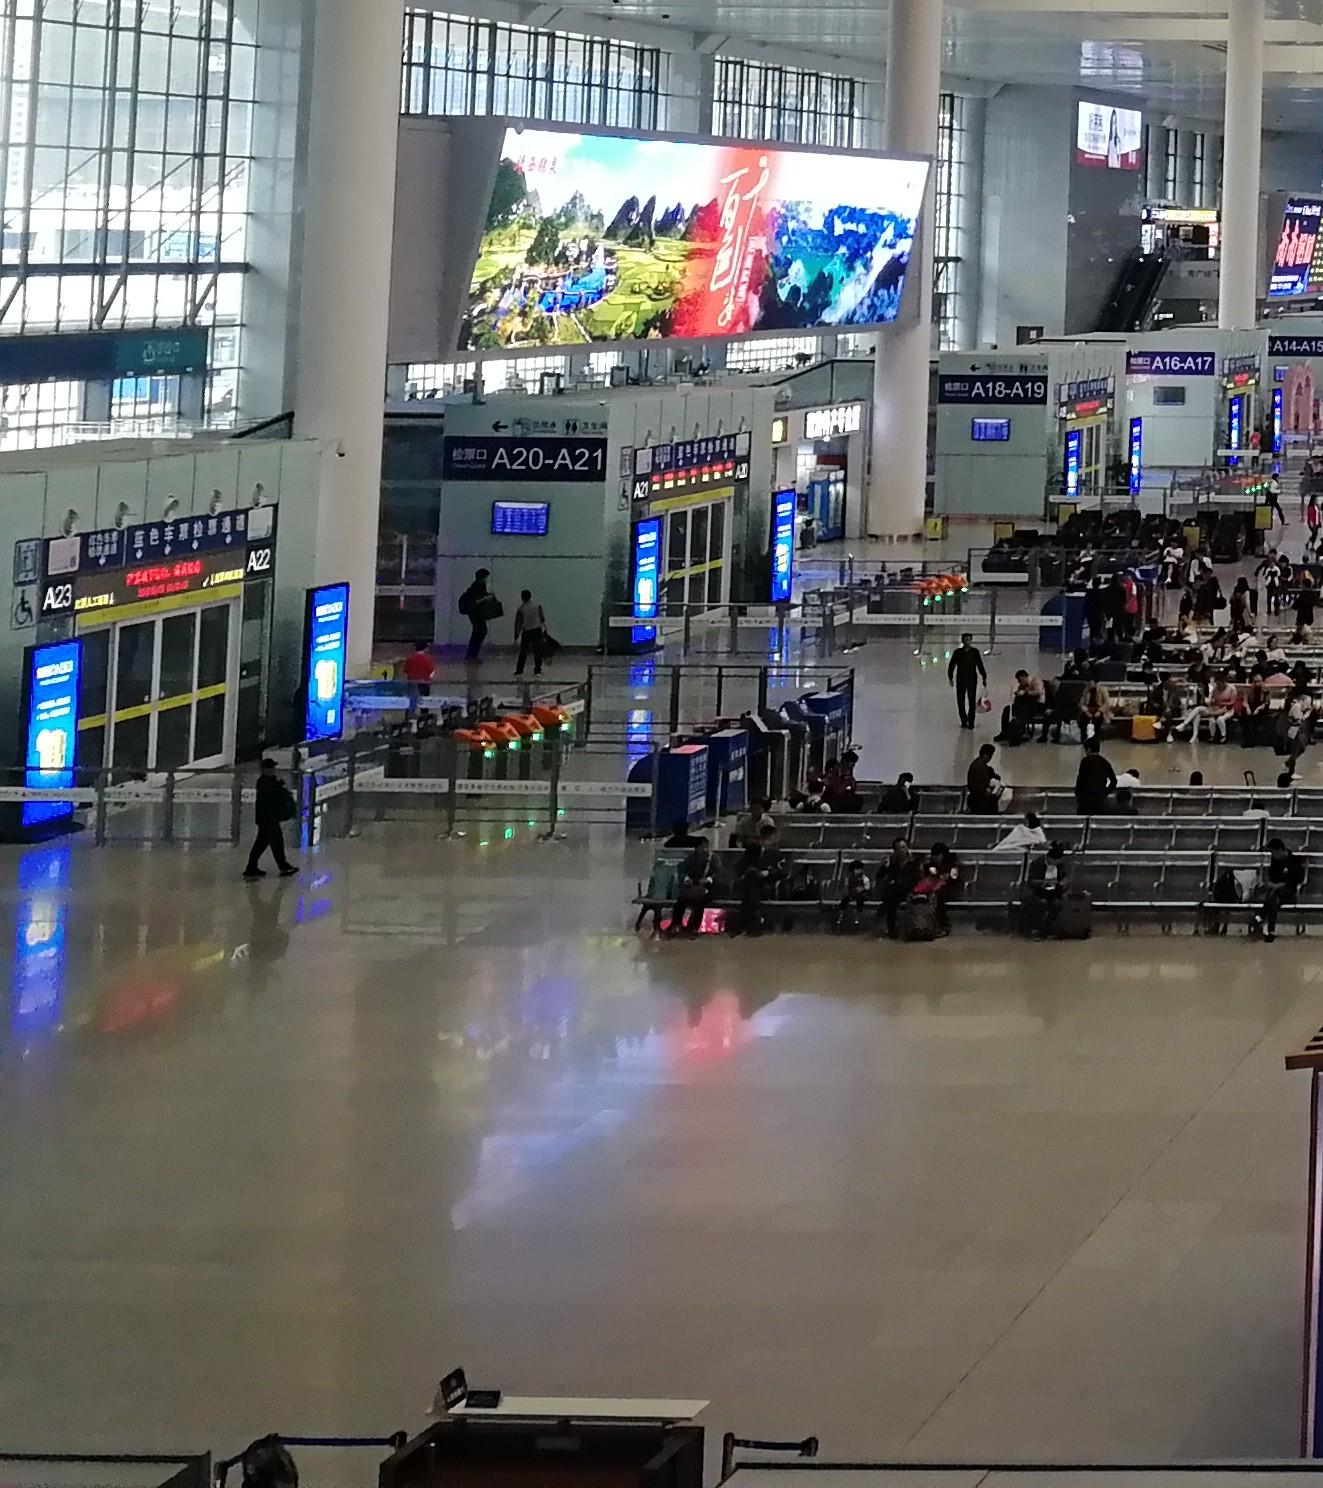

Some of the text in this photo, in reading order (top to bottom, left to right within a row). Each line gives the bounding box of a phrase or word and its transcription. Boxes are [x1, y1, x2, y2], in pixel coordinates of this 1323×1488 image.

[1151, 357, 1212, 370] A16-A17
[971, 381, 1045, 398] A18-A19
[491, 447, 604, 470] A20-A21
[633, 481, 649, 499] A21
[246, 548, 271, 572] A22
[42, 583, 72, 611] A23
